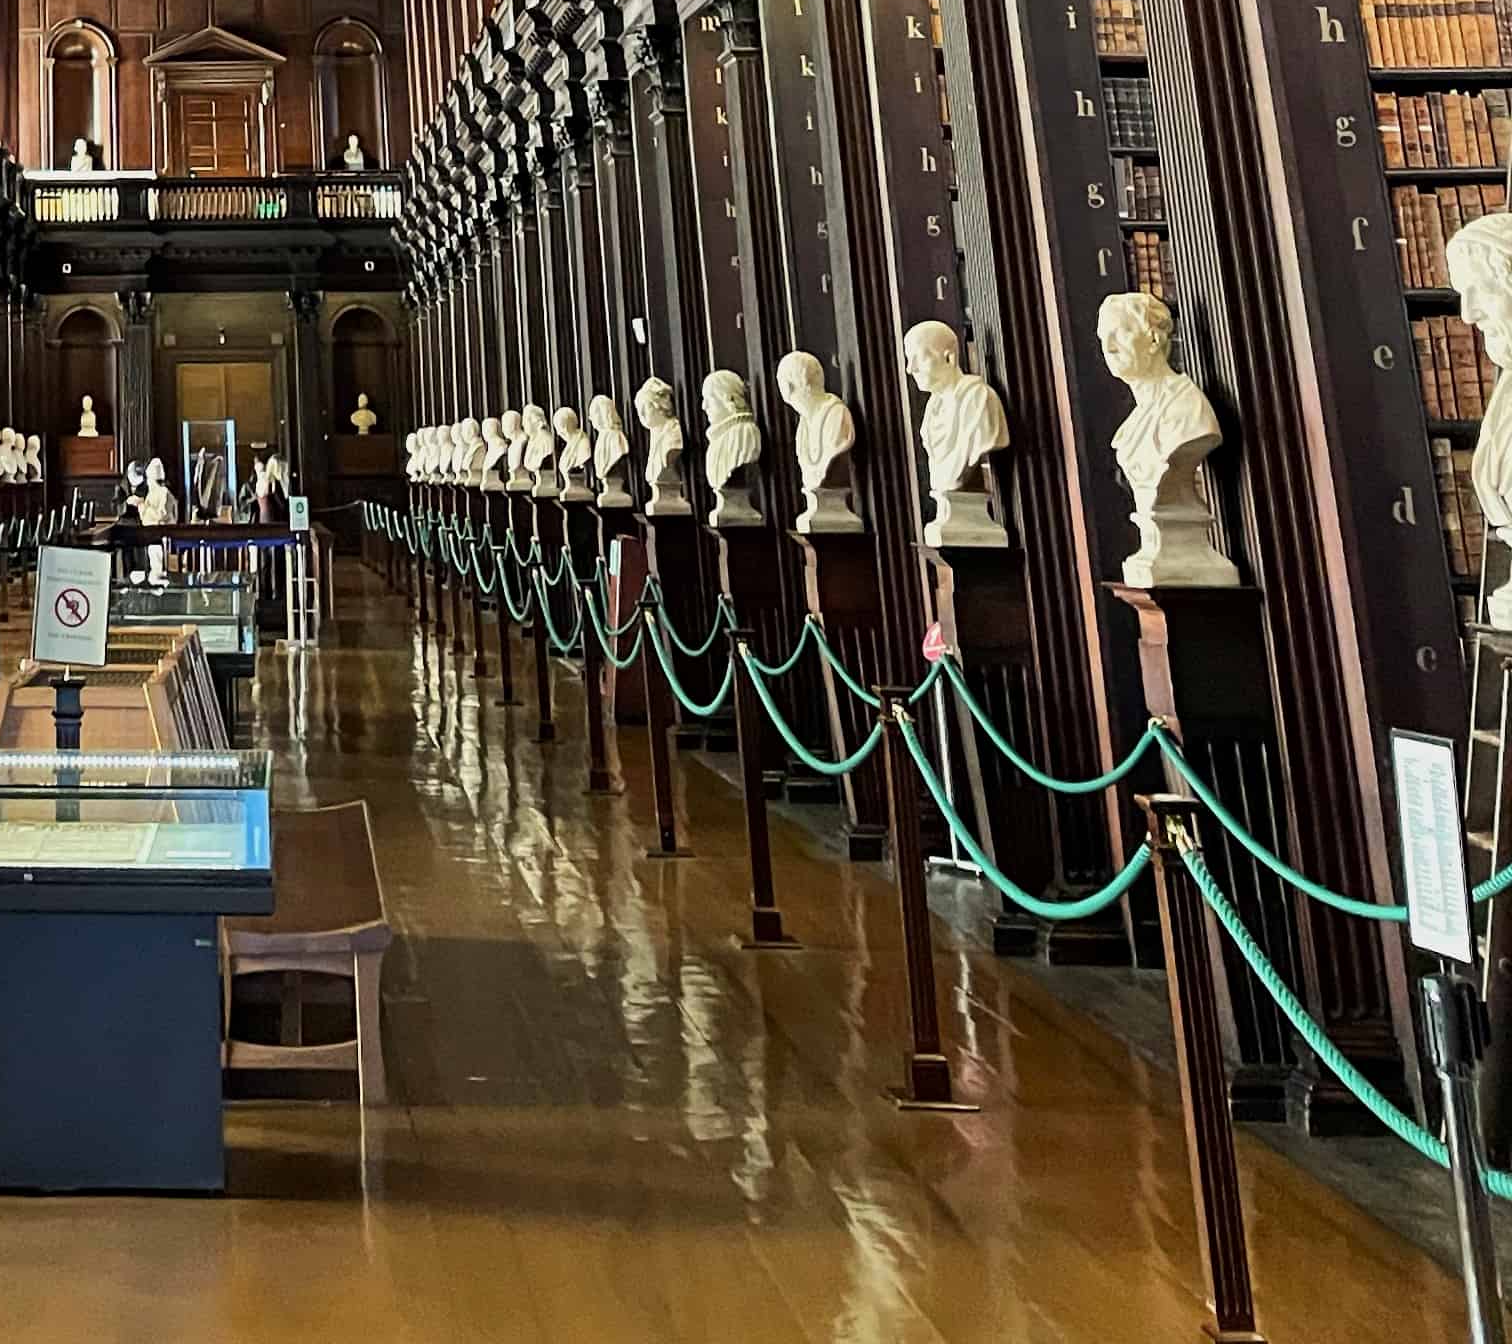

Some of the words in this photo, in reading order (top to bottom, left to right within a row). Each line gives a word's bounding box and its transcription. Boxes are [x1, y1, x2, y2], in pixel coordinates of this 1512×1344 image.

[905, 15, 926, 39] k
[1066, 5, 1077, 29] i
[1314, 6, 1347, 43] h
[800, 54, 816, 77] k
[913, 72, 922, 93] i
[1074, 90, 1097, 117] h
[1335, 116, 1357, 148] g
[920, 147, 937, 172] h
[810, 166, 823, 185] h
[1087, 182, 1105, 208] g
[927, 214, 940, 237] g
[1352, 216, 1369, 251] f
[1098, 247, 1113, 276] f
[936, 275, 948, 300] f
[1373, 344, 1394, 370] e
[1392, 485, 1416, 526] d
